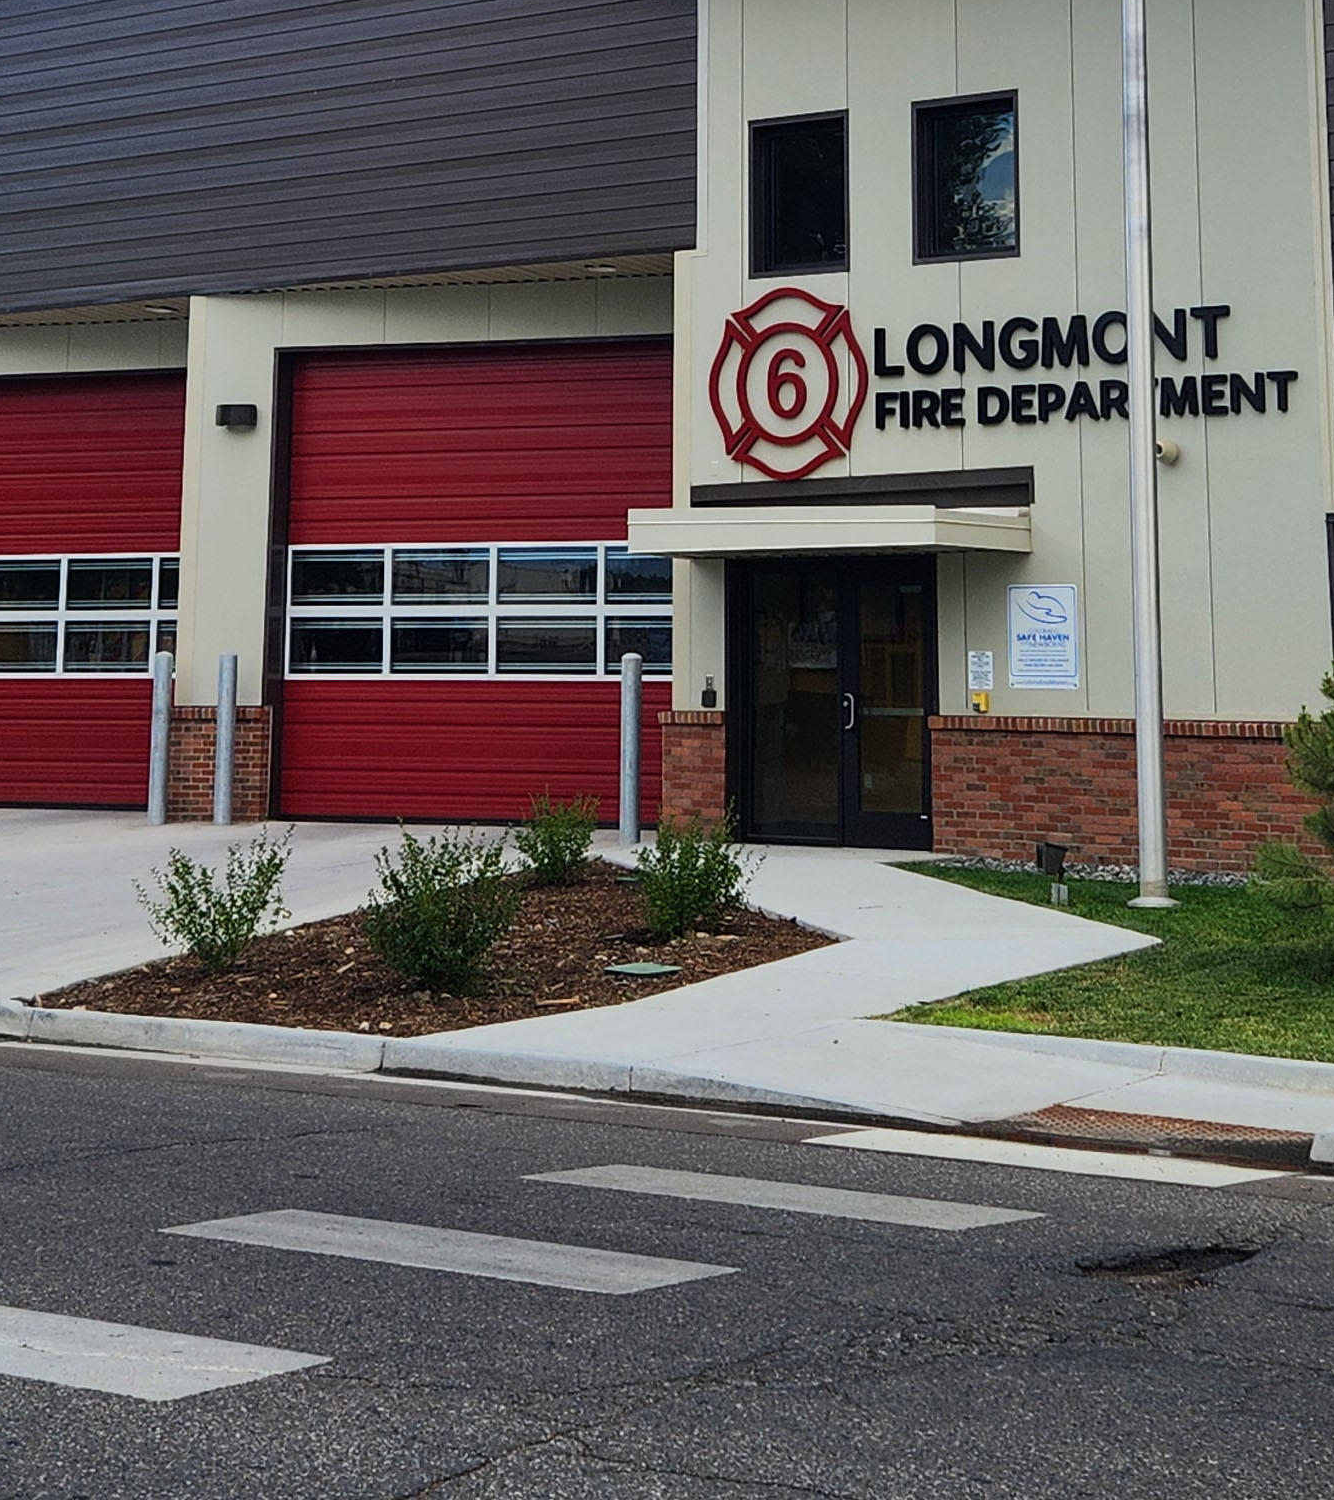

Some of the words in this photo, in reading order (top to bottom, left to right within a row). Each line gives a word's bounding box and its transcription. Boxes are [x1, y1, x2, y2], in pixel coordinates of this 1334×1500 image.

[873, 304, 1231, 377] LONGMONT
[767, 348, 807, 419] 6
[874, 387, 966, 430] FIRE
[976, 370, 1299, 426] DEPARMENT
[1016, 634, 1037, 642] SAFE
[1040, 634, 1070, 642] HAVEN
